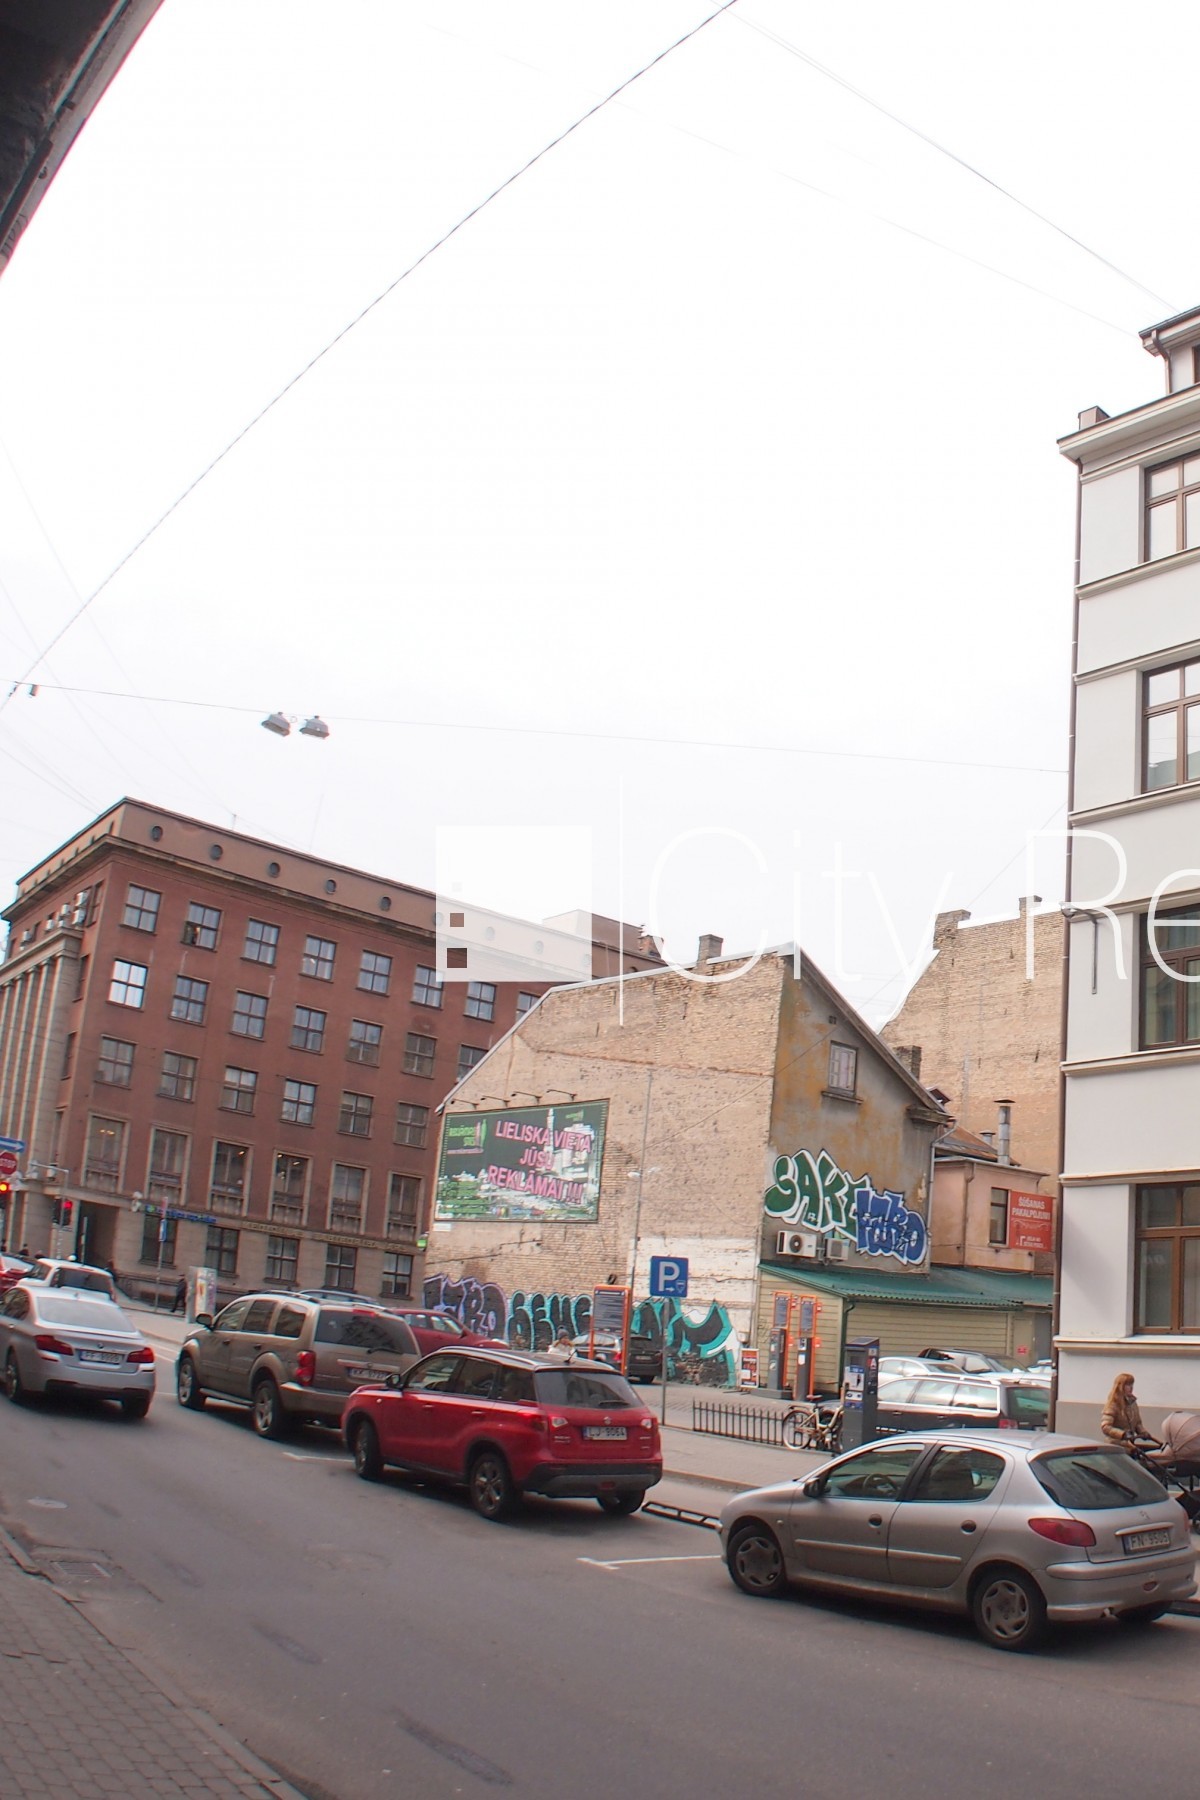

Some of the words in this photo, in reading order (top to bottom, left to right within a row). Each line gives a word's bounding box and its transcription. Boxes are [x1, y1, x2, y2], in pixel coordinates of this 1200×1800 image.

[495, 1120, 549, 1145] LIELISKA
[553, 1130, 592, 1153] VIETA
[487, 1165, 563, 1200] REKLĀMAI
[658, 1261, 679, 1291] P
